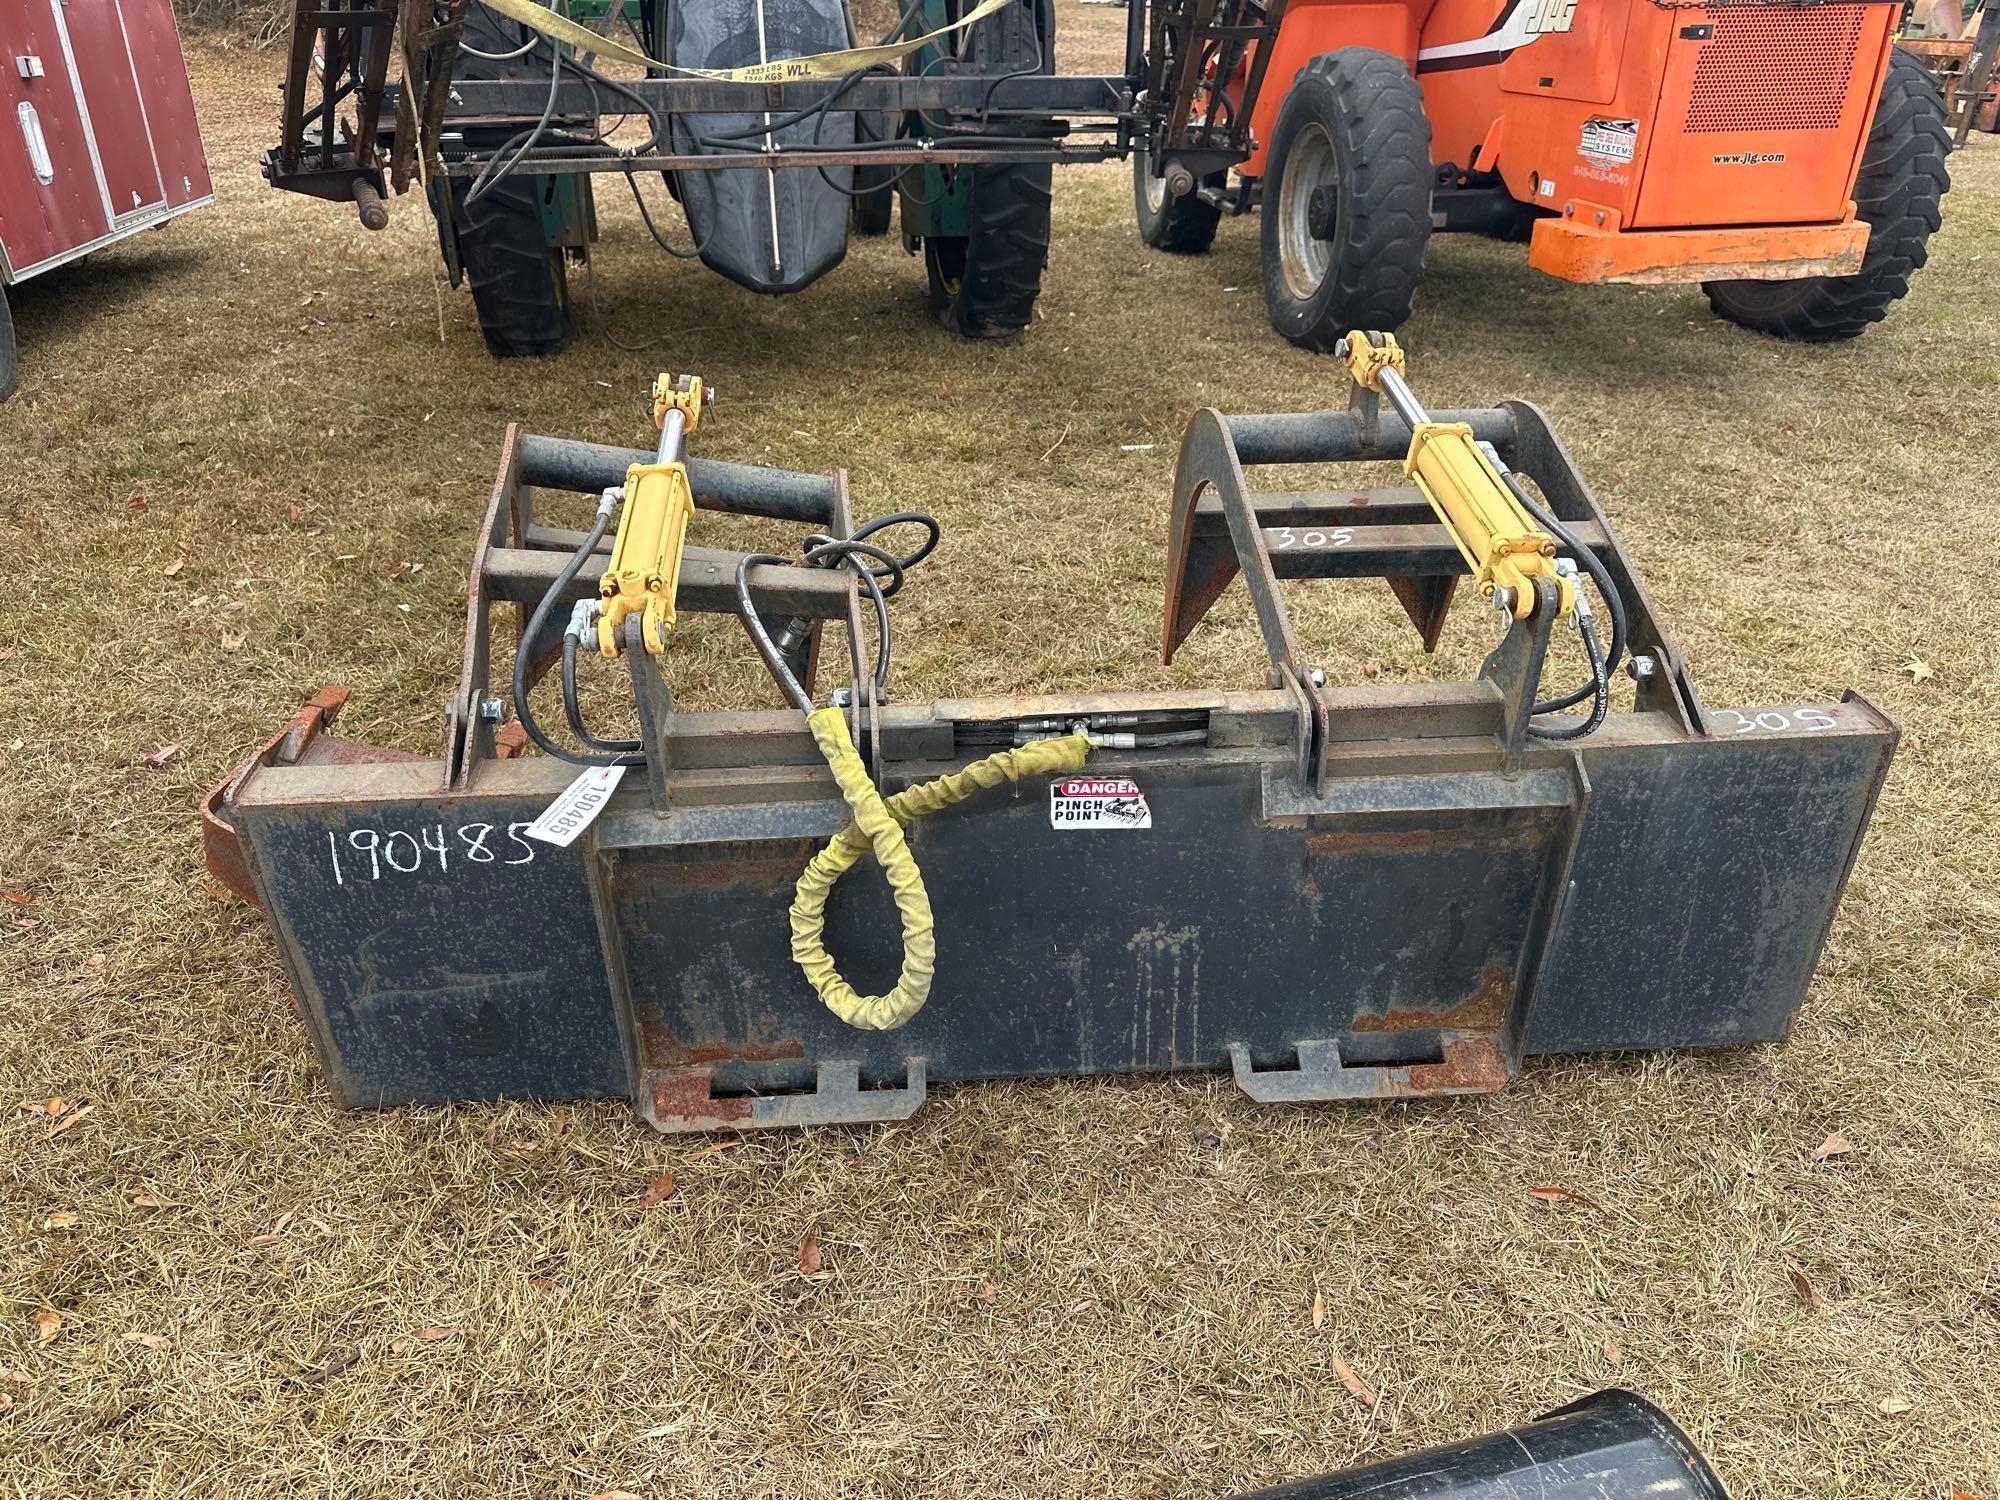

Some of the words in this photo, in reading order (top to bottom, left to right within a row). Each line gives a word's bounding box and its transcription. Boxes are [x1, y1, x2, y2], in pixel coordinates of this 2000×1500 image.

[1525, 0, 1578, 34] JLG
[766, 63, 782, 73] LBS
[787, 63, 811, 76] WLL
[764, 72, 783, 81] KGS
[1595, 143, 1633, 156] SYSTEMS
[1713, 152, 1785, 165] www.jlg.com
[1266, 527, 1355, 549] 305
[1709, 708, 1837, 733] 305
[549, 785, 608, 837] 190485
[1055, 800, 1103, 810] PINCH
[1055, 810, 1102, 821] POINT
[328, 821, 536, 885] 190485
